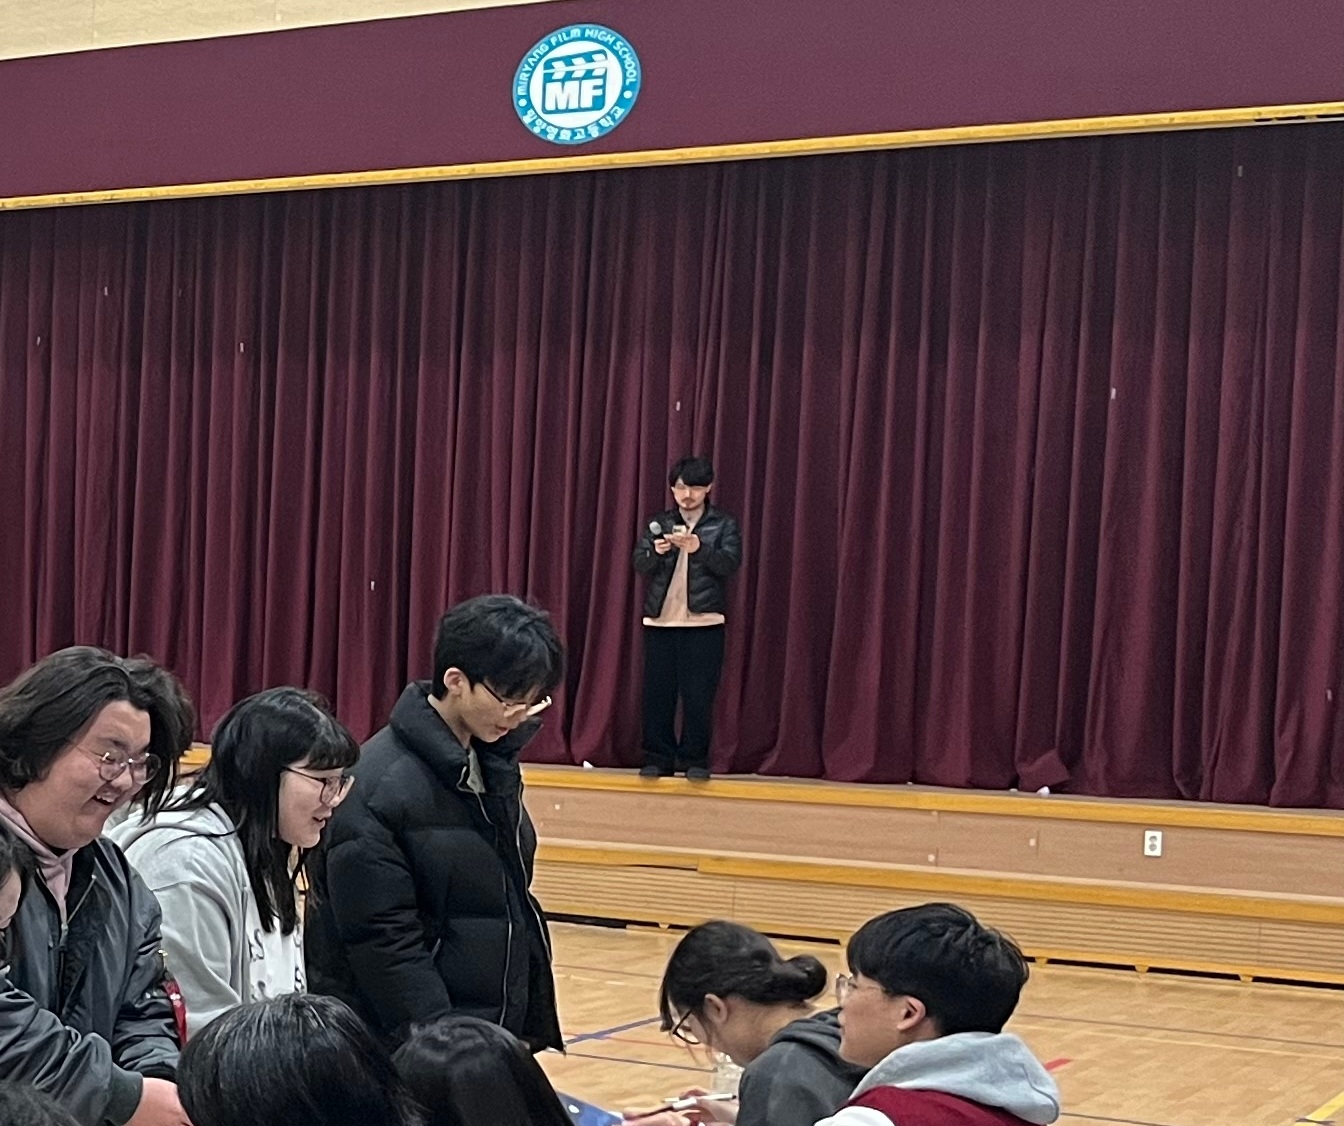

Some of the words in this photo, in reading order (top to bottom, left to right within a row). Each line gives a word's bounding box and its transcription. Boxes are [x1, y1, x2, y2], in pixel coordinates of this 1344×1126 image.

[584, 28, 616, 45] HIGH
[612, 41, 637, 86] SCHOOL
[544, 78, 604, 111] MF
